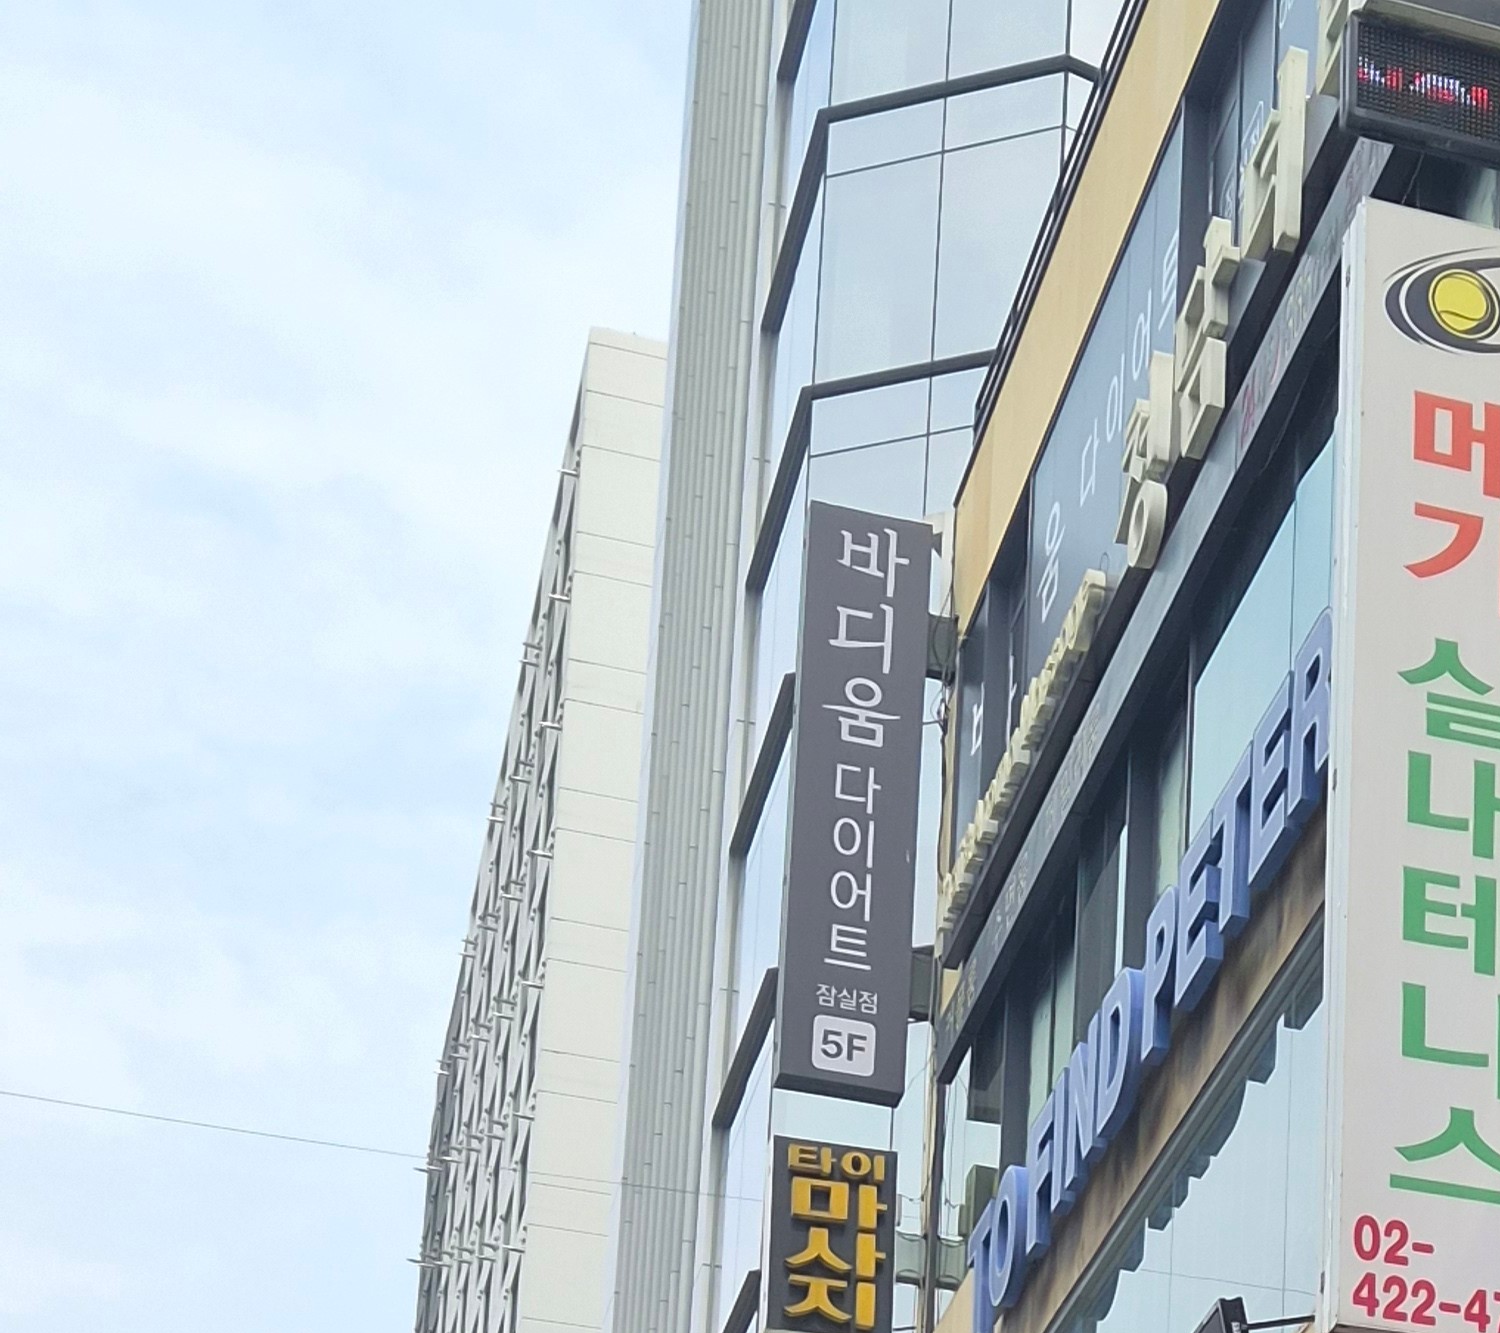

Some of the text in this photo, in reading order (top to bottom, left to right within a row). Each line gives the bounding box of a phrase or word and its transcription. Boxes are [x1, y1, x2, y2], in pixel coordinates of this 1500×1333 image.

[822, 526, 910, 749] 바디움
[822, 761, 884, 973] 다이어트
[1025, 966, 1147, 1260] FIND
[1141, 606, 1333, 1067] PETER
[814, 982, 880, 1015] 잠실점
[821, 1025, 867, 1064] 5F
[786, 1143, 886, 1182] 타이
[783, 1177, 887, 1332] 마사지
[1353, 1214, 1435, 1267] 02-
